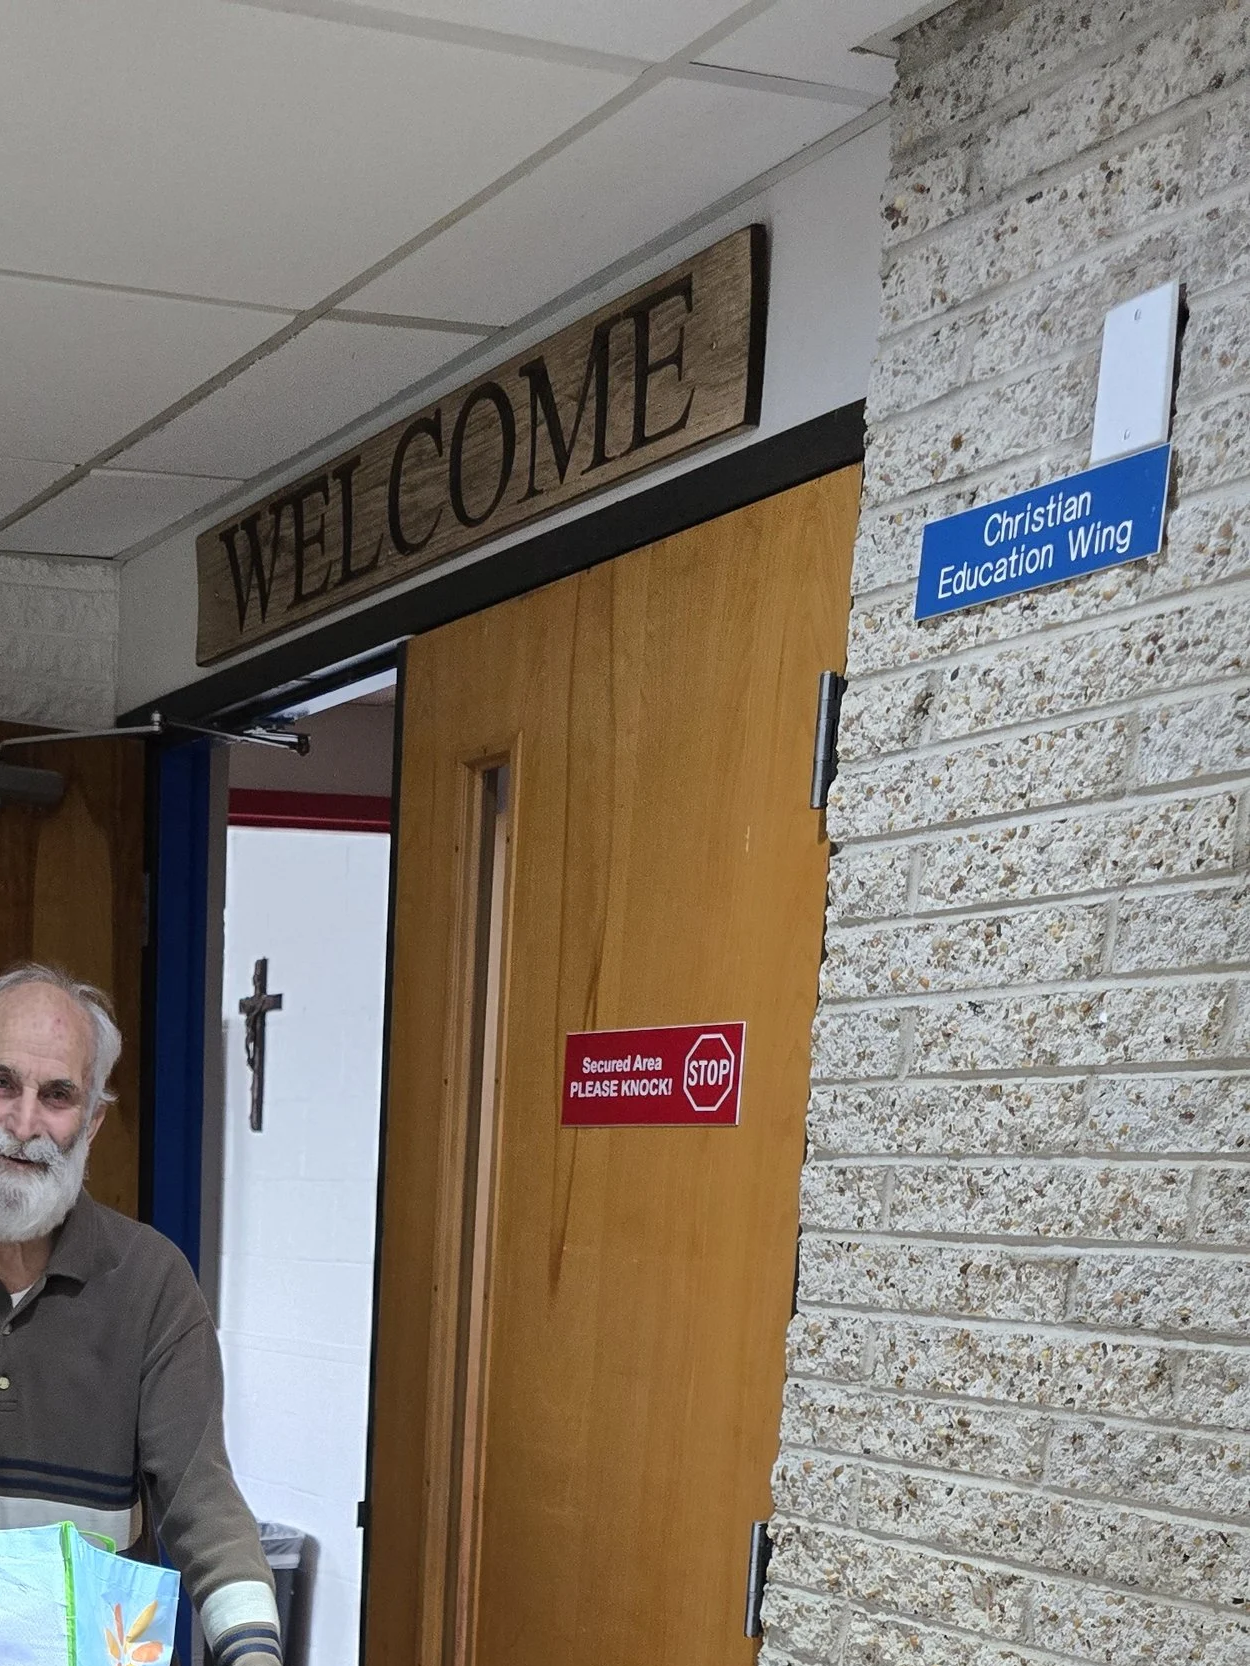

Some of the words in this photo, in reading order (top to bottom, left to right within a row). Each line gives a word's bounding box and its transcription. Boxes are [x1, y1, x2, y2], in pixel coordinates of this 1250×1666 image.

[219, 272, 696, 634] WELCOME
[983, 491, 1092, 547] Christian
[937, 543, 1054, 600] Education
[1068, 520, 1133, 562] Wing
[582, 1055, 631, 1074] Secured
[633, 1054, 662, 1072] Area
[687, 1058, 730, 1087] STOP
[570, 1080, 619, 1098] PLEASE
[621, 1078, 673, 1097] KNOCK!
